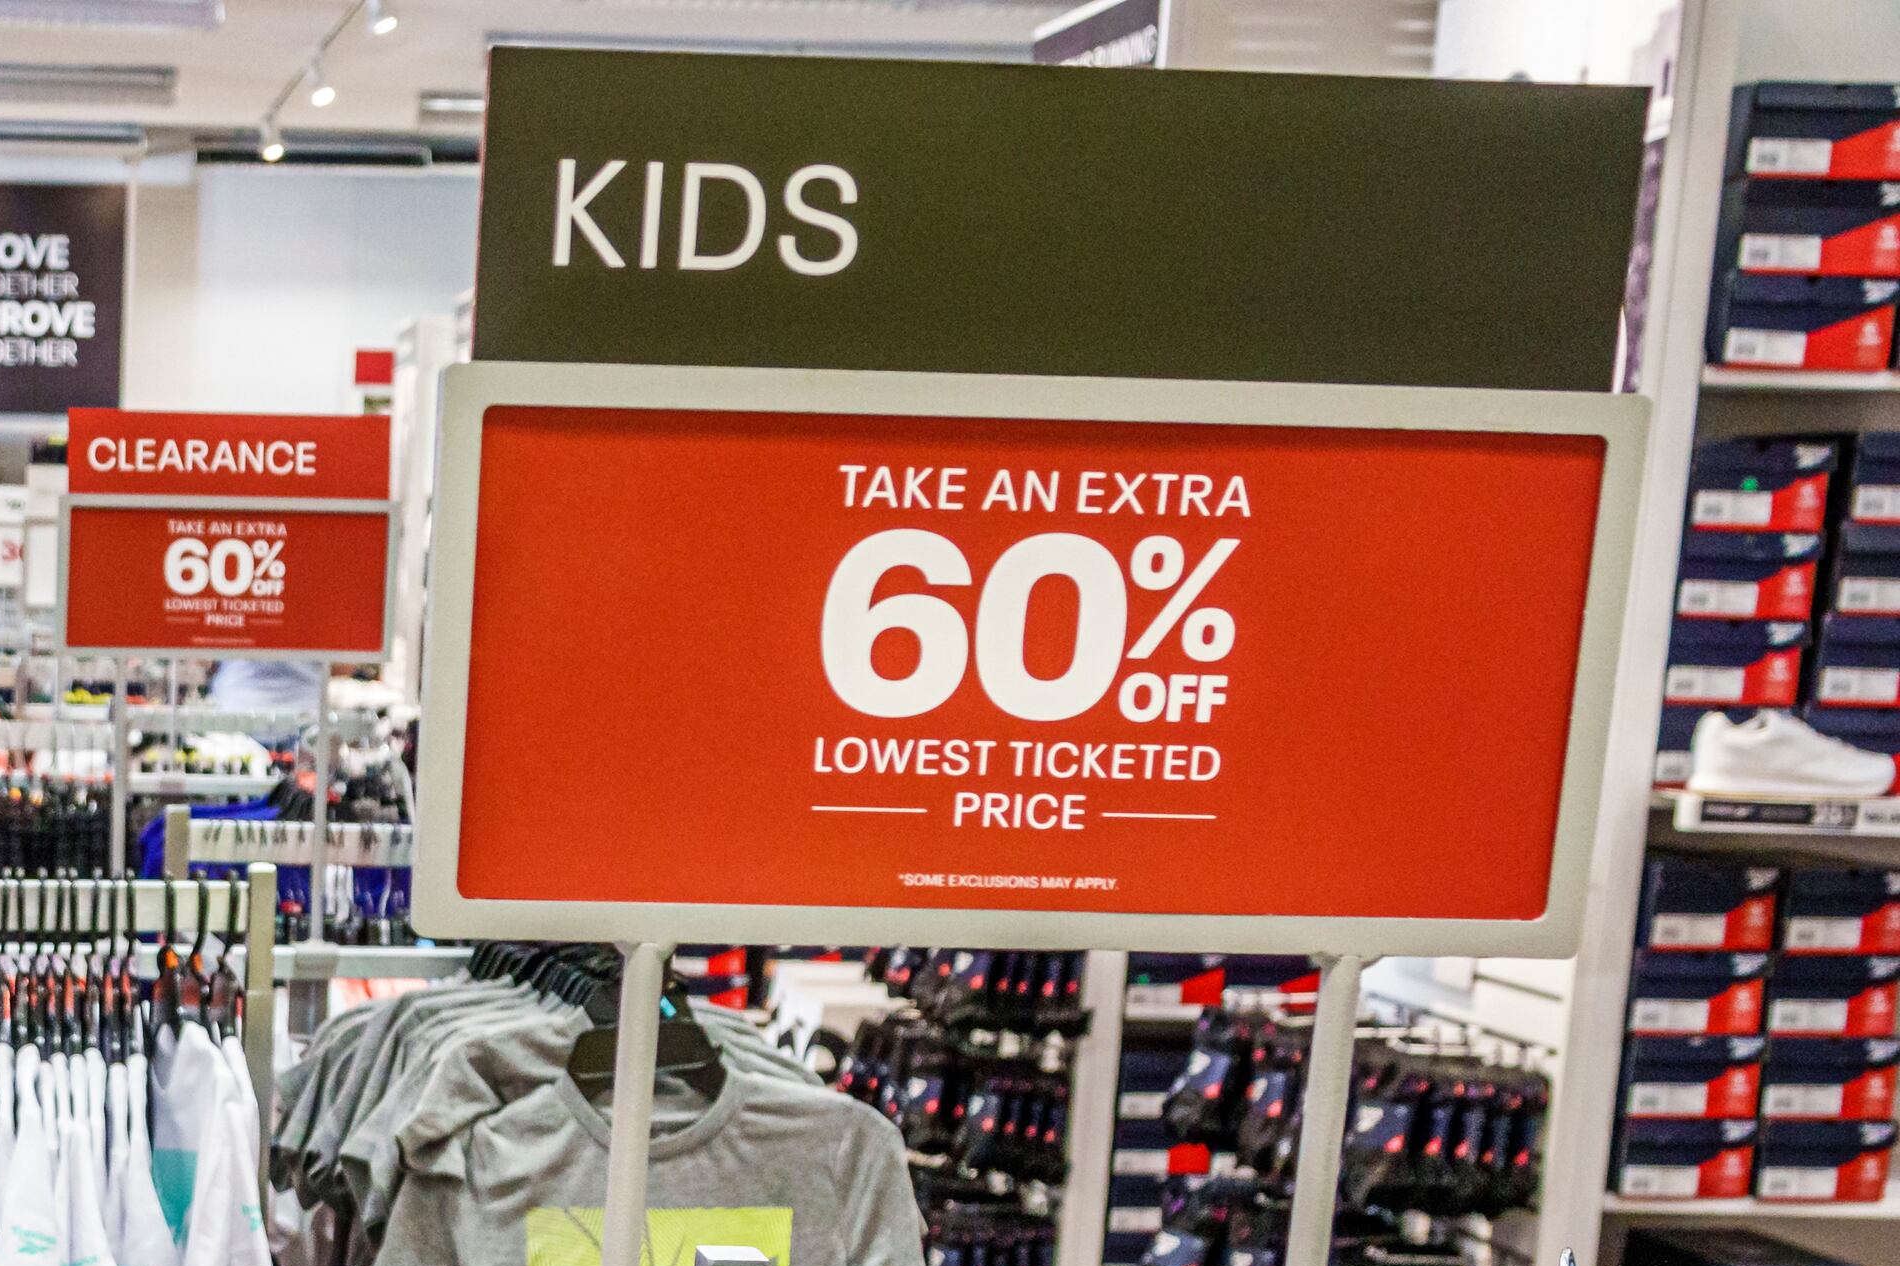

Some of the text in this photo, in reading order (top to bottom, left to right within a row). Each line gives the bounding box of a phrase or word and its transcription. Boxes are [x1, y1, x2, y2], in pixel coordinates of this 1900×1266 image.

[553, 158, 858, 276] KIDS
[87, 436, 317, 476] CLEARANCE
[838, 464, 1251, 517] TAKE AN EXTRA
[167, 519, 288, 538] TAKE AN EXTRA
[163, 537, 287, 598] 60% OFF
[163, 598, 285, 614] LOWEST TICKETED
[204, 613, 245, 628] PRICE
[820, 528, 1241, 723] 60% OFF
[813, 736, 1222, 782] LOWEST TICKETED
[953, 791, 1088, 831] PRICE
[947, 873, 1040, 889] EXCLUSIONS
[1040, 875, 1073, 889] MAY
[1074, 876, 1120, 891] APPLY.
